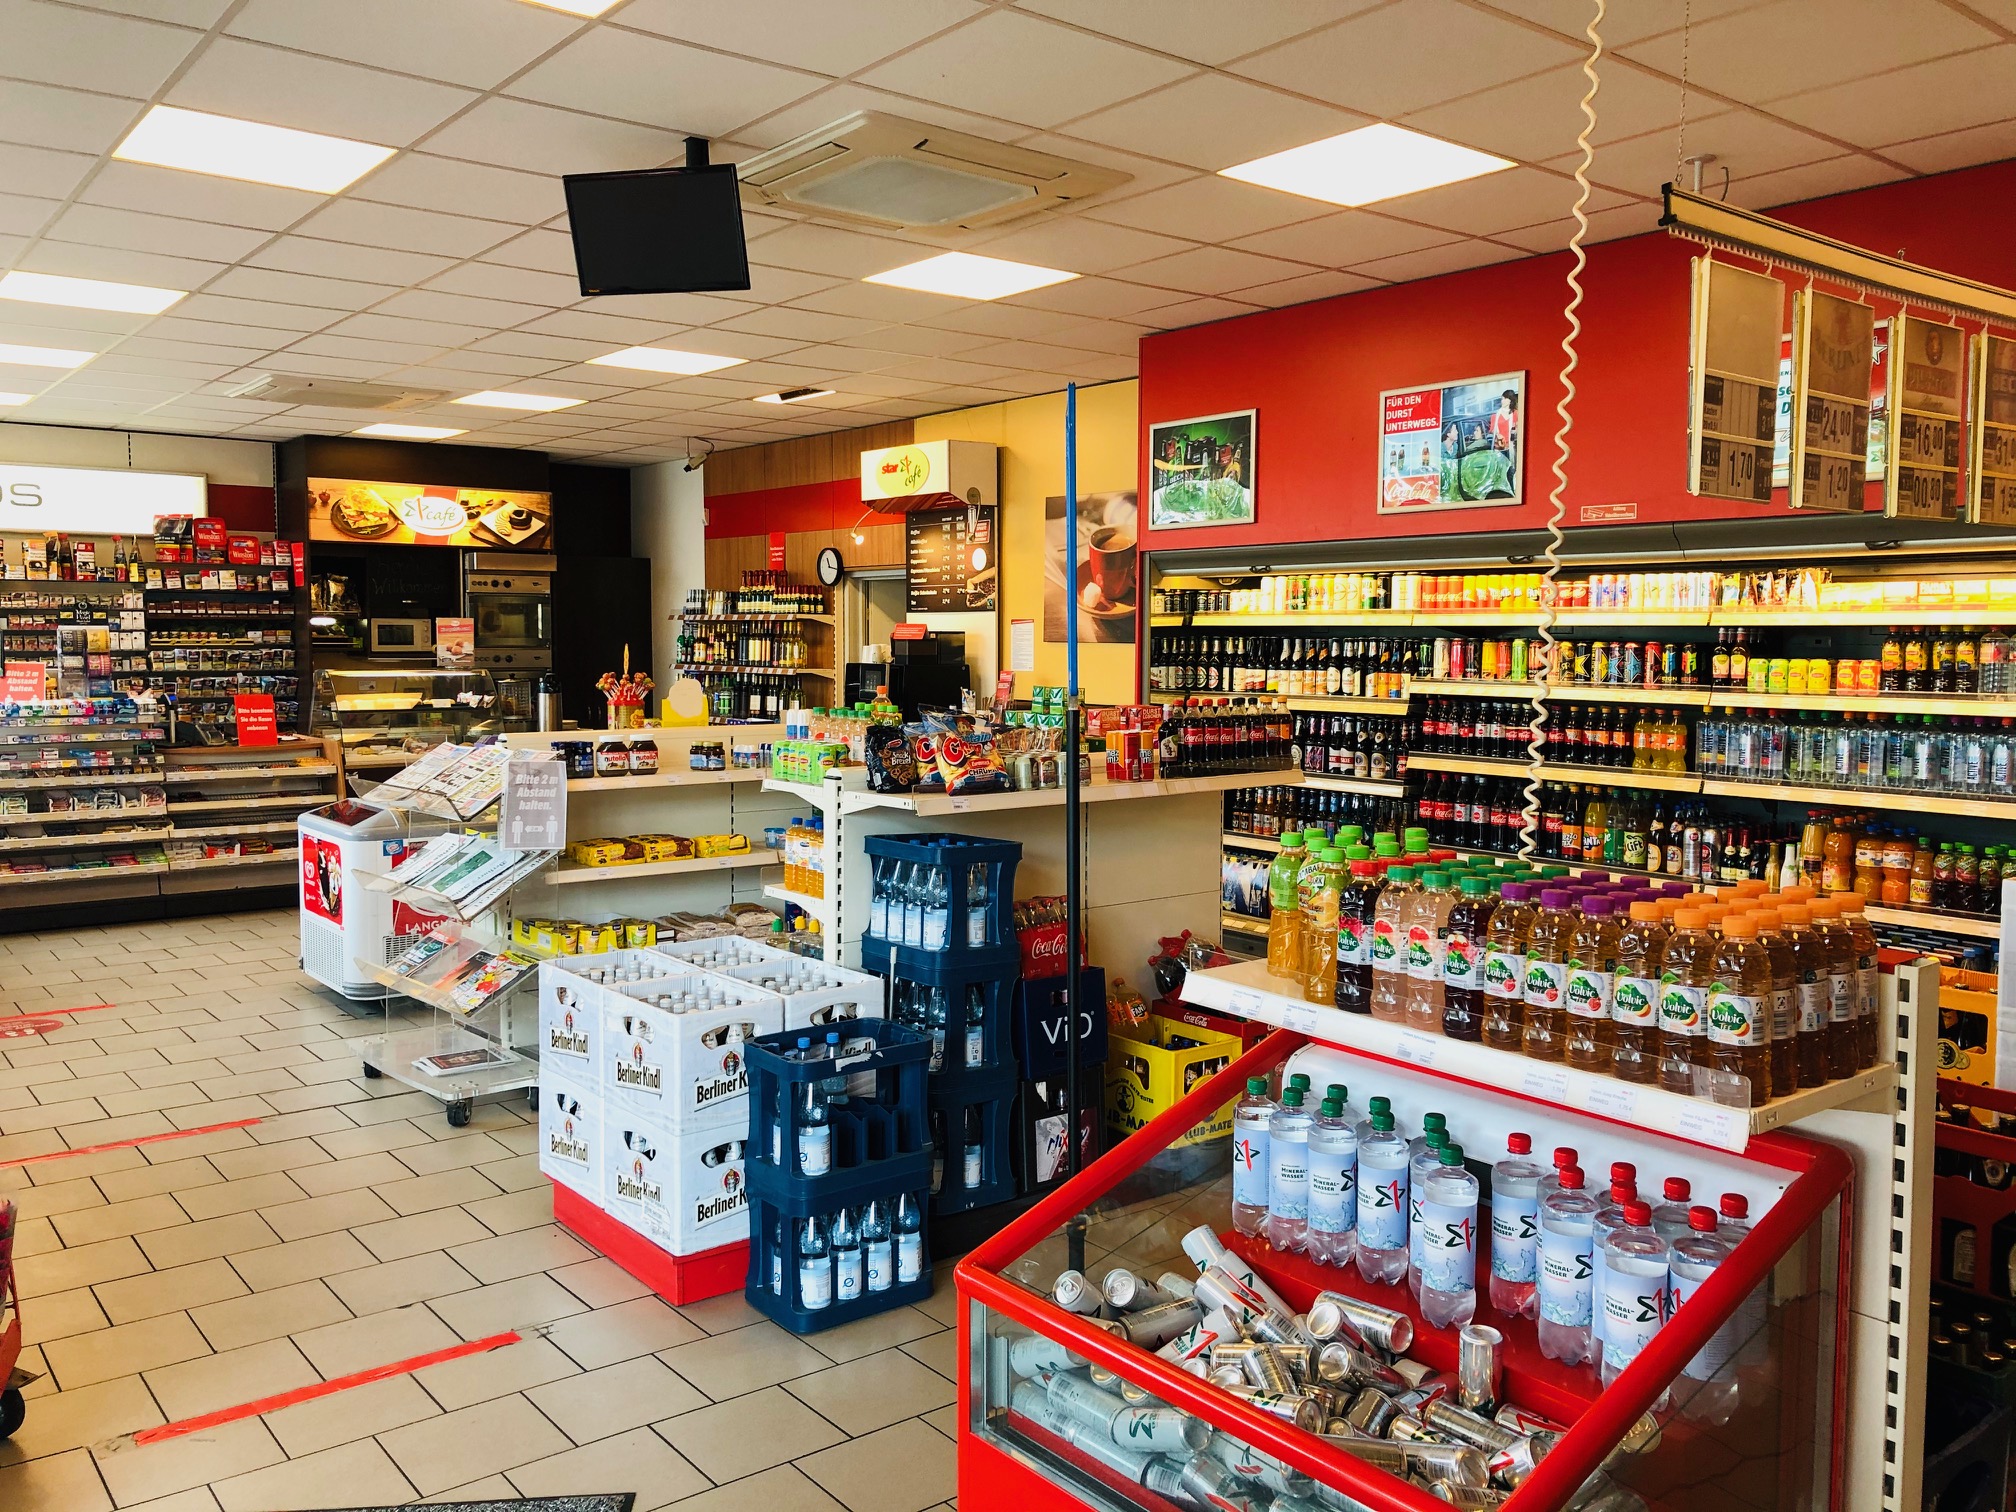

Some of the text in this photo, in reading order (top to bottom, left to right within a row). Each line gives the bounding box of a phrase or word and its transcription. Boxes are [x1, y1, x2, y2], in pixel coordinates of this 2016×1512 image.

[1386, 395, 1422, 408] FÜR DEN
[1386, 408, 1413, 420] DURST
[1386, 418, 1439, 432] UNTERWEGS.
[882, 463, 899, 474] star
[1729, 450, 1752, 487] 1.70
[905, 464, 921, 488] café
[426, 506, 456, 526] café
[892, 751, 909, 759] Snack
[516, 774, 558, 785] Bitte 2 m
[517, 787, 557, 798] Abstand
[519, 800, 552, 810] halten.
[1583, 836, 1600, 846] ANTA
[1447, 956, 1470, 971] Volvic
[1486, 966, 1511, 979] Volvic
[1527, 975, 1554, 989] Volvic
[1569, 984, 1596, 998] Volvic
[1616, 992, 1646, 1006] Volvic
[1662, 1000, 1692, 1015] Volvic
[1183, 1012, 1208, 1028] Coca-Cola
[1711, 1008, 1744, 1025] Volvic
[1719, 1022, 1732, 1031] TEE
[551, 1029, 588, 1054] Berliner Kindl
[617, 1062, 661, 1089] Berliner Kindl
[696, 1078, 736, 1104] Berliner
[1589, 1095, 1609, 1107] EINWEG
[1680, 1119, 1703, 1131] EINWEG
[551, 1134, 588, 1162] Berliner Kindl
[617, 1175, 661, 1202] Berliner Kindl
[1313, 1178, 1340, 1187] MINERAL-
[1313, 1183, 1335, 1192] WASSER
[697, 1197, 737, 1222] Berliner
[1493, 1220, 1518, 1232] MINERAL-
[1493, 1226, 1513, 1237] WASSER
[1545, 1259, 1574, 1272] MINERAL-
[1545, 1266, 1568, 1278] WASSER
[1605, 1299, 1635, 1314] MINERAL-
[1605, 1306, 1628, 1320] WASSER
